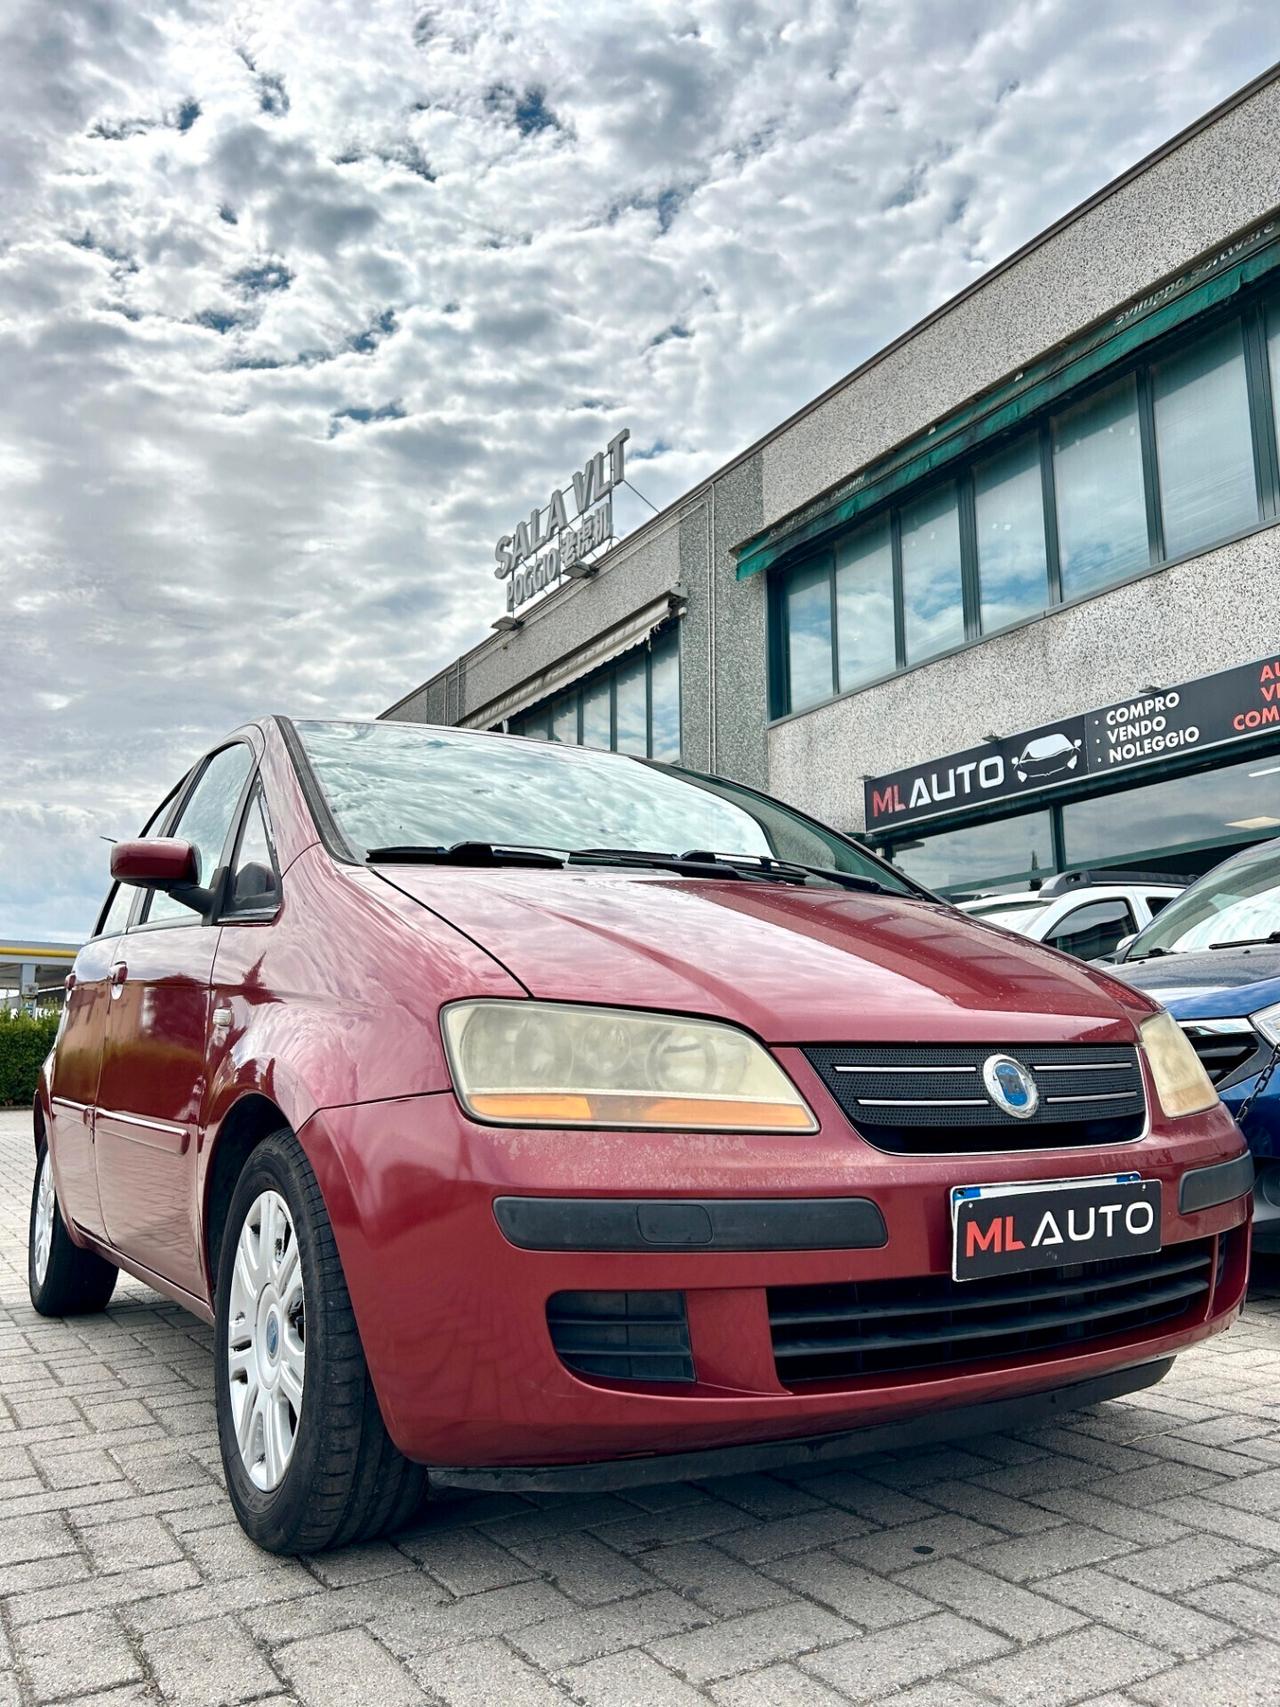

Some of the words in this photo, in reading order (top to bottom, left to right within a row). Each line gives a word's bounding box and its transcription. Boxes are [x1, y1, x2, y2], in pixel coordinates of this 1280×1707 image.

[494, 488, 569, 580] SALA
[572, 428, 630, 514] VLT
[507, 547, 559, 612] POGGIO
[1106, 692, 1180, 726] COMPRO
[1107, 715, 1167, 744] VENDO
[1233, 704, 1280, 731] COM
[1109, 726, 1200, 764] NOLEGGIO
[909, 755, 1005, 809] AUTO
[965, 1215, 1026, 1258] ML
[1030, 1200, 1155, 1248] AUTO
